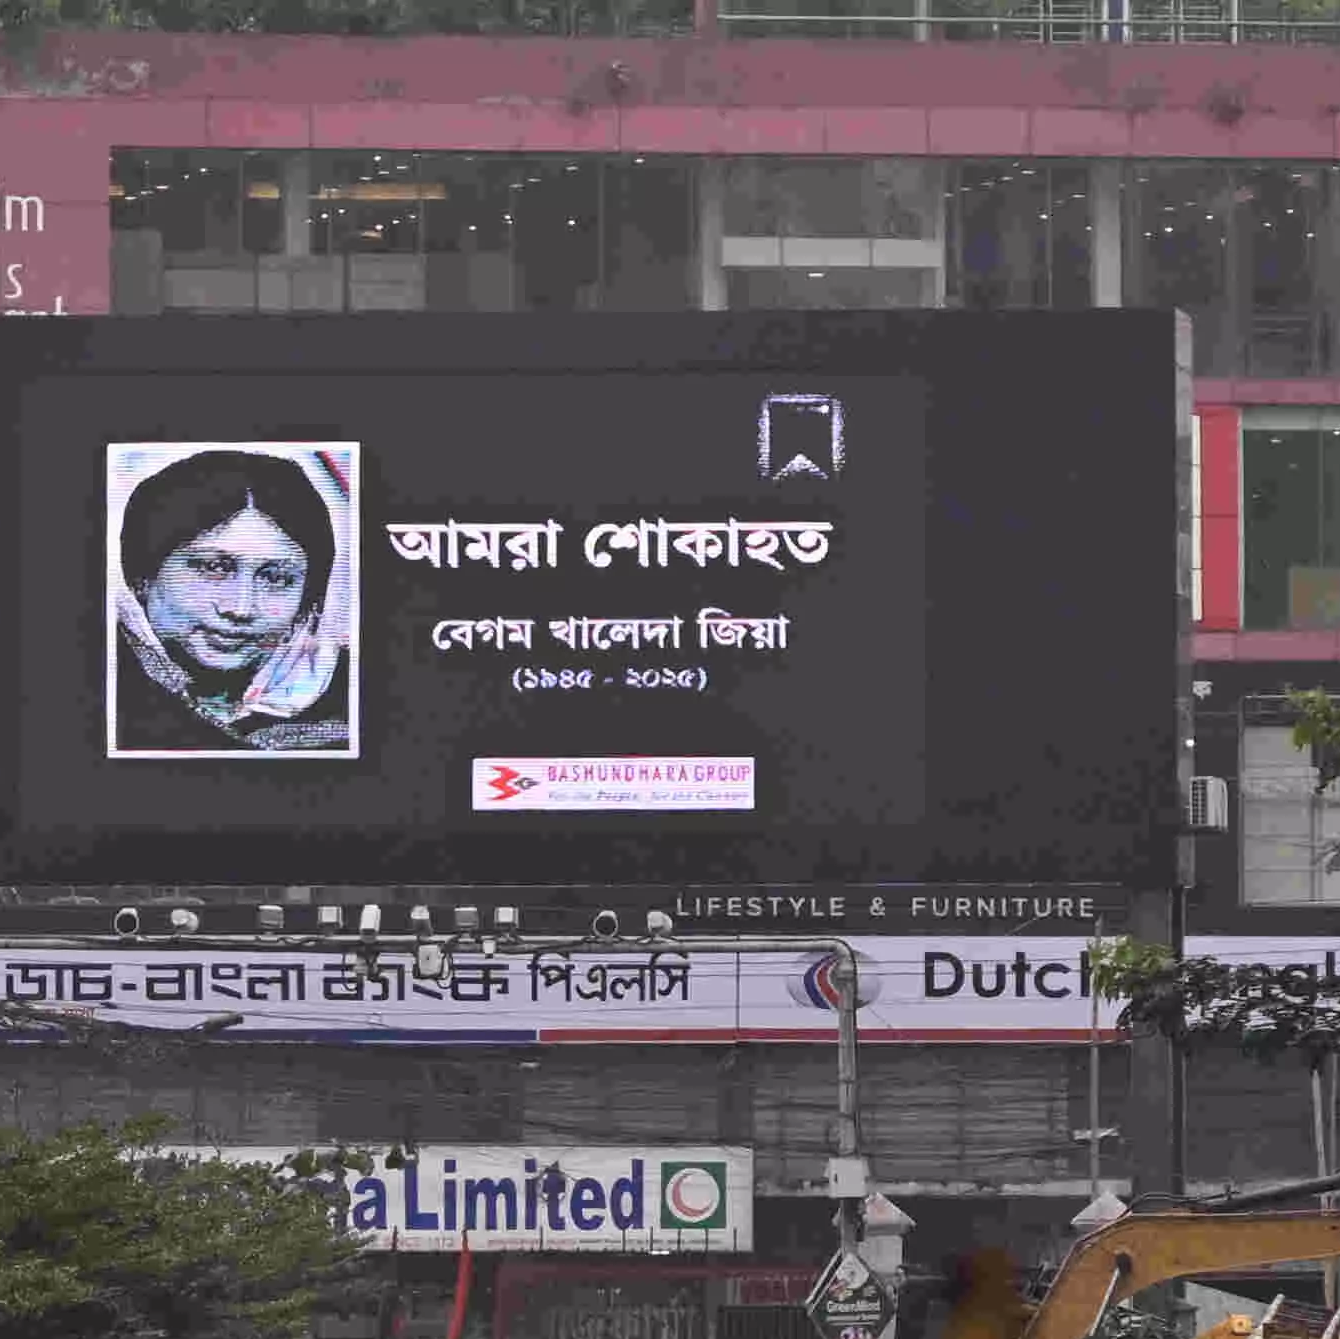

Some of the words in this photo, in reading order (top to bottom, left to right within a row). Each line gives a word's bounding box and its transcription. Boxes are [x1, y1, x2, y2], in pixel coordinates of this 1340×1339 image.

[386, 518, 563, 570] আমরা
[584, 517, 834, 571] শোকাহত
[432, 616, 535, 651] বেগম
[548, 615, 684, 651] খালেদা
[696, 607, 790, 650] জিয়া
[512, 667, 595, 691] (১৯৪৫
[625, 667, 708, 691] ২০২৫)
[547, 765, 689, 783] BASHUNDHARA
[693, 764, 751, 783] GROUP
[676, 897, 846, 917] LIFESTYLE
[869, 896, 887, 916] &
[911, 896, 1095, 918] FURNITURE
[526, 951, 691, 1002] পিএলসি
[404, 1158, 644, 1231] Limited
